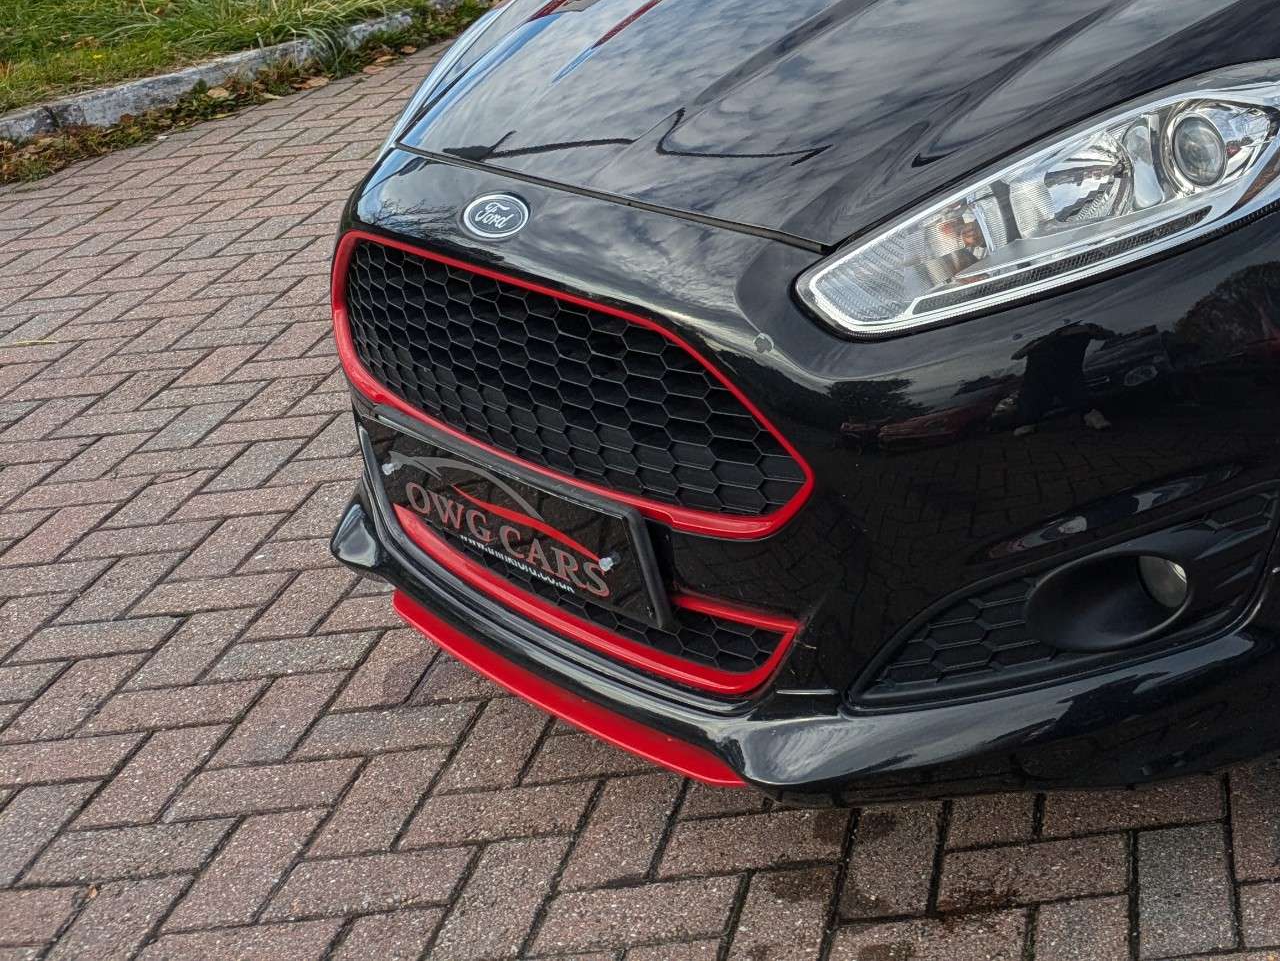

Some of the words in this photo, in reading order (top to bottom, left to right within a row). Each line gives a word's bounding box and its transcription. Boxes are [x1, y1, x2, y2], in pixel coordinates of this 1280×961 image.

[474, 202, 515, 229] Ford
[405, 481, 494, 543] OWG
[499, 524, 611, 598] CARS
